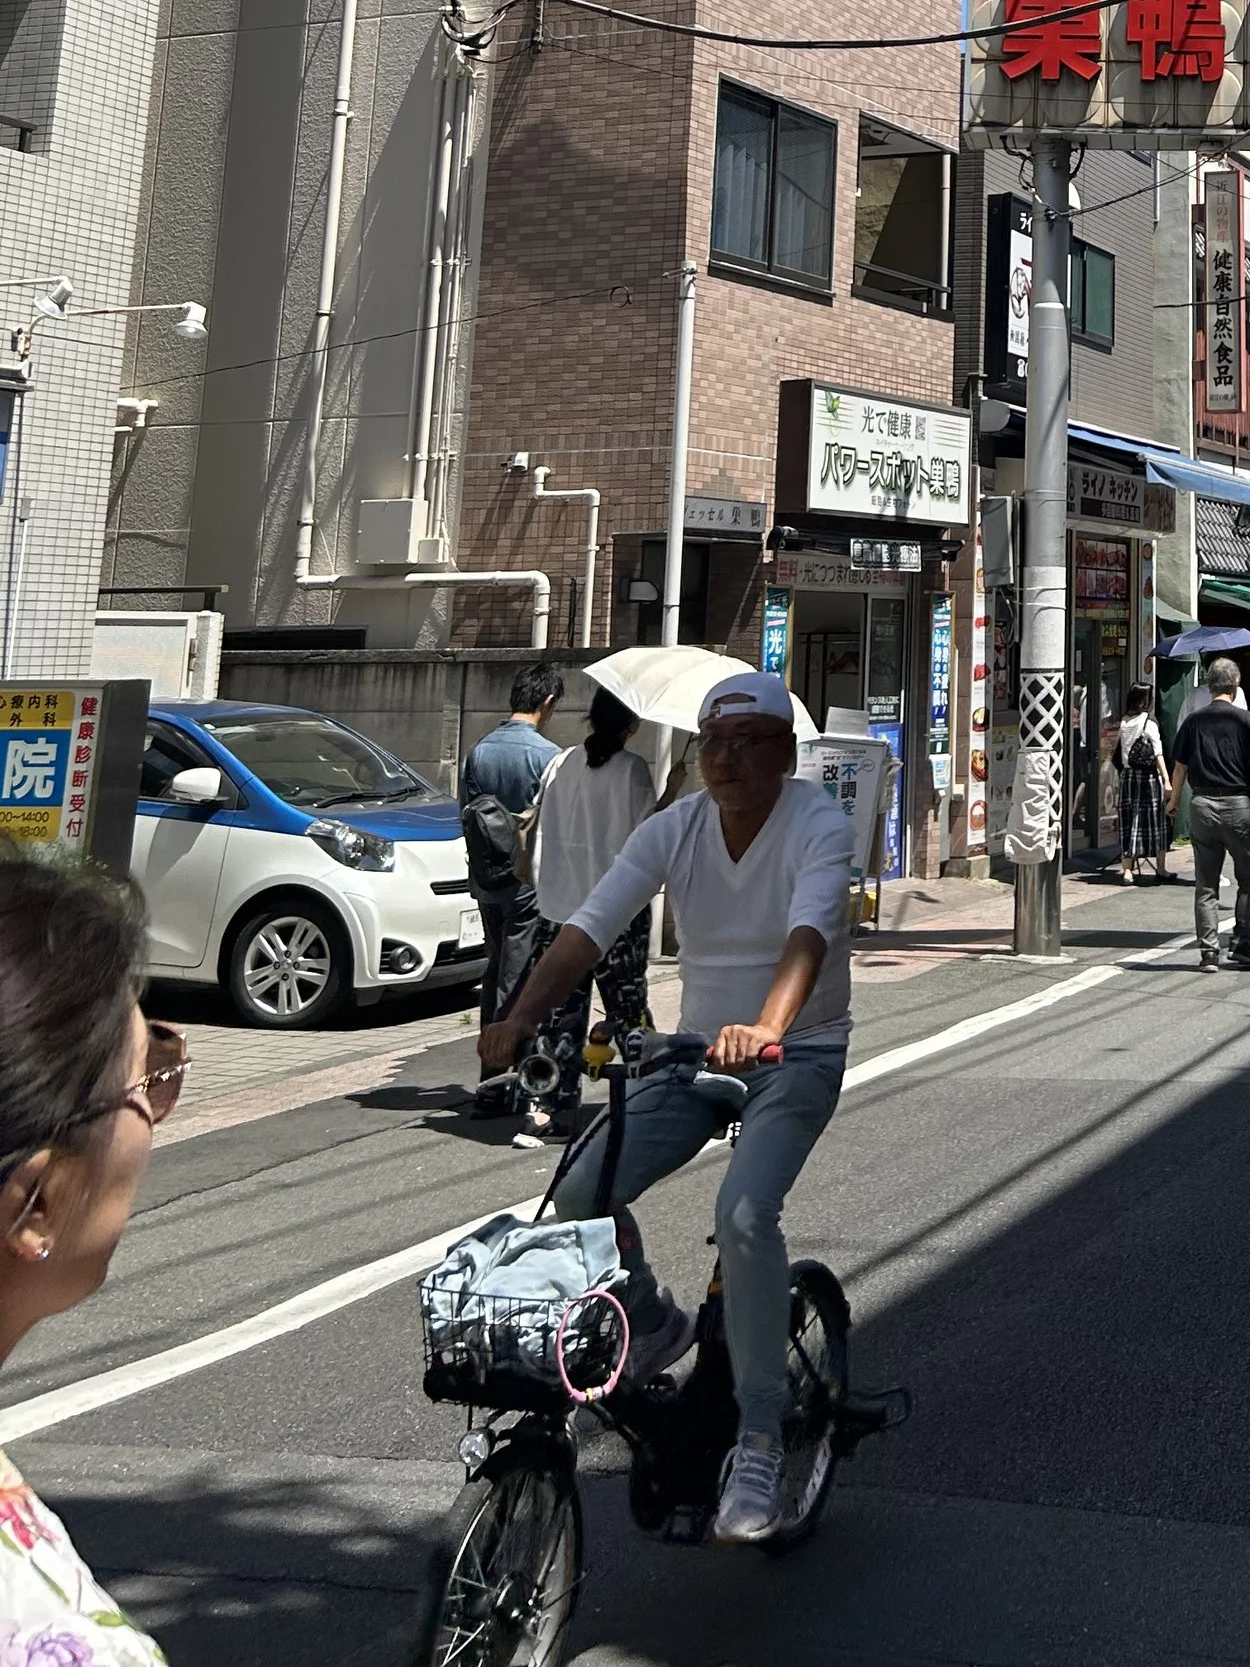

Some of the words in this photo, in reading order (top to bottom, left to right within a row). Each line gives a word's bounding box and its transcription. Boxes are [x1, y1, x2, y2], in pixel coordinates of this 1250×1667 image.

[1212, 249, 1234, 388] 健康自然食品
[820, 442, 961, 499] パワースポット巣鴨
[66, 696, 98, 838] 健康診断受付
